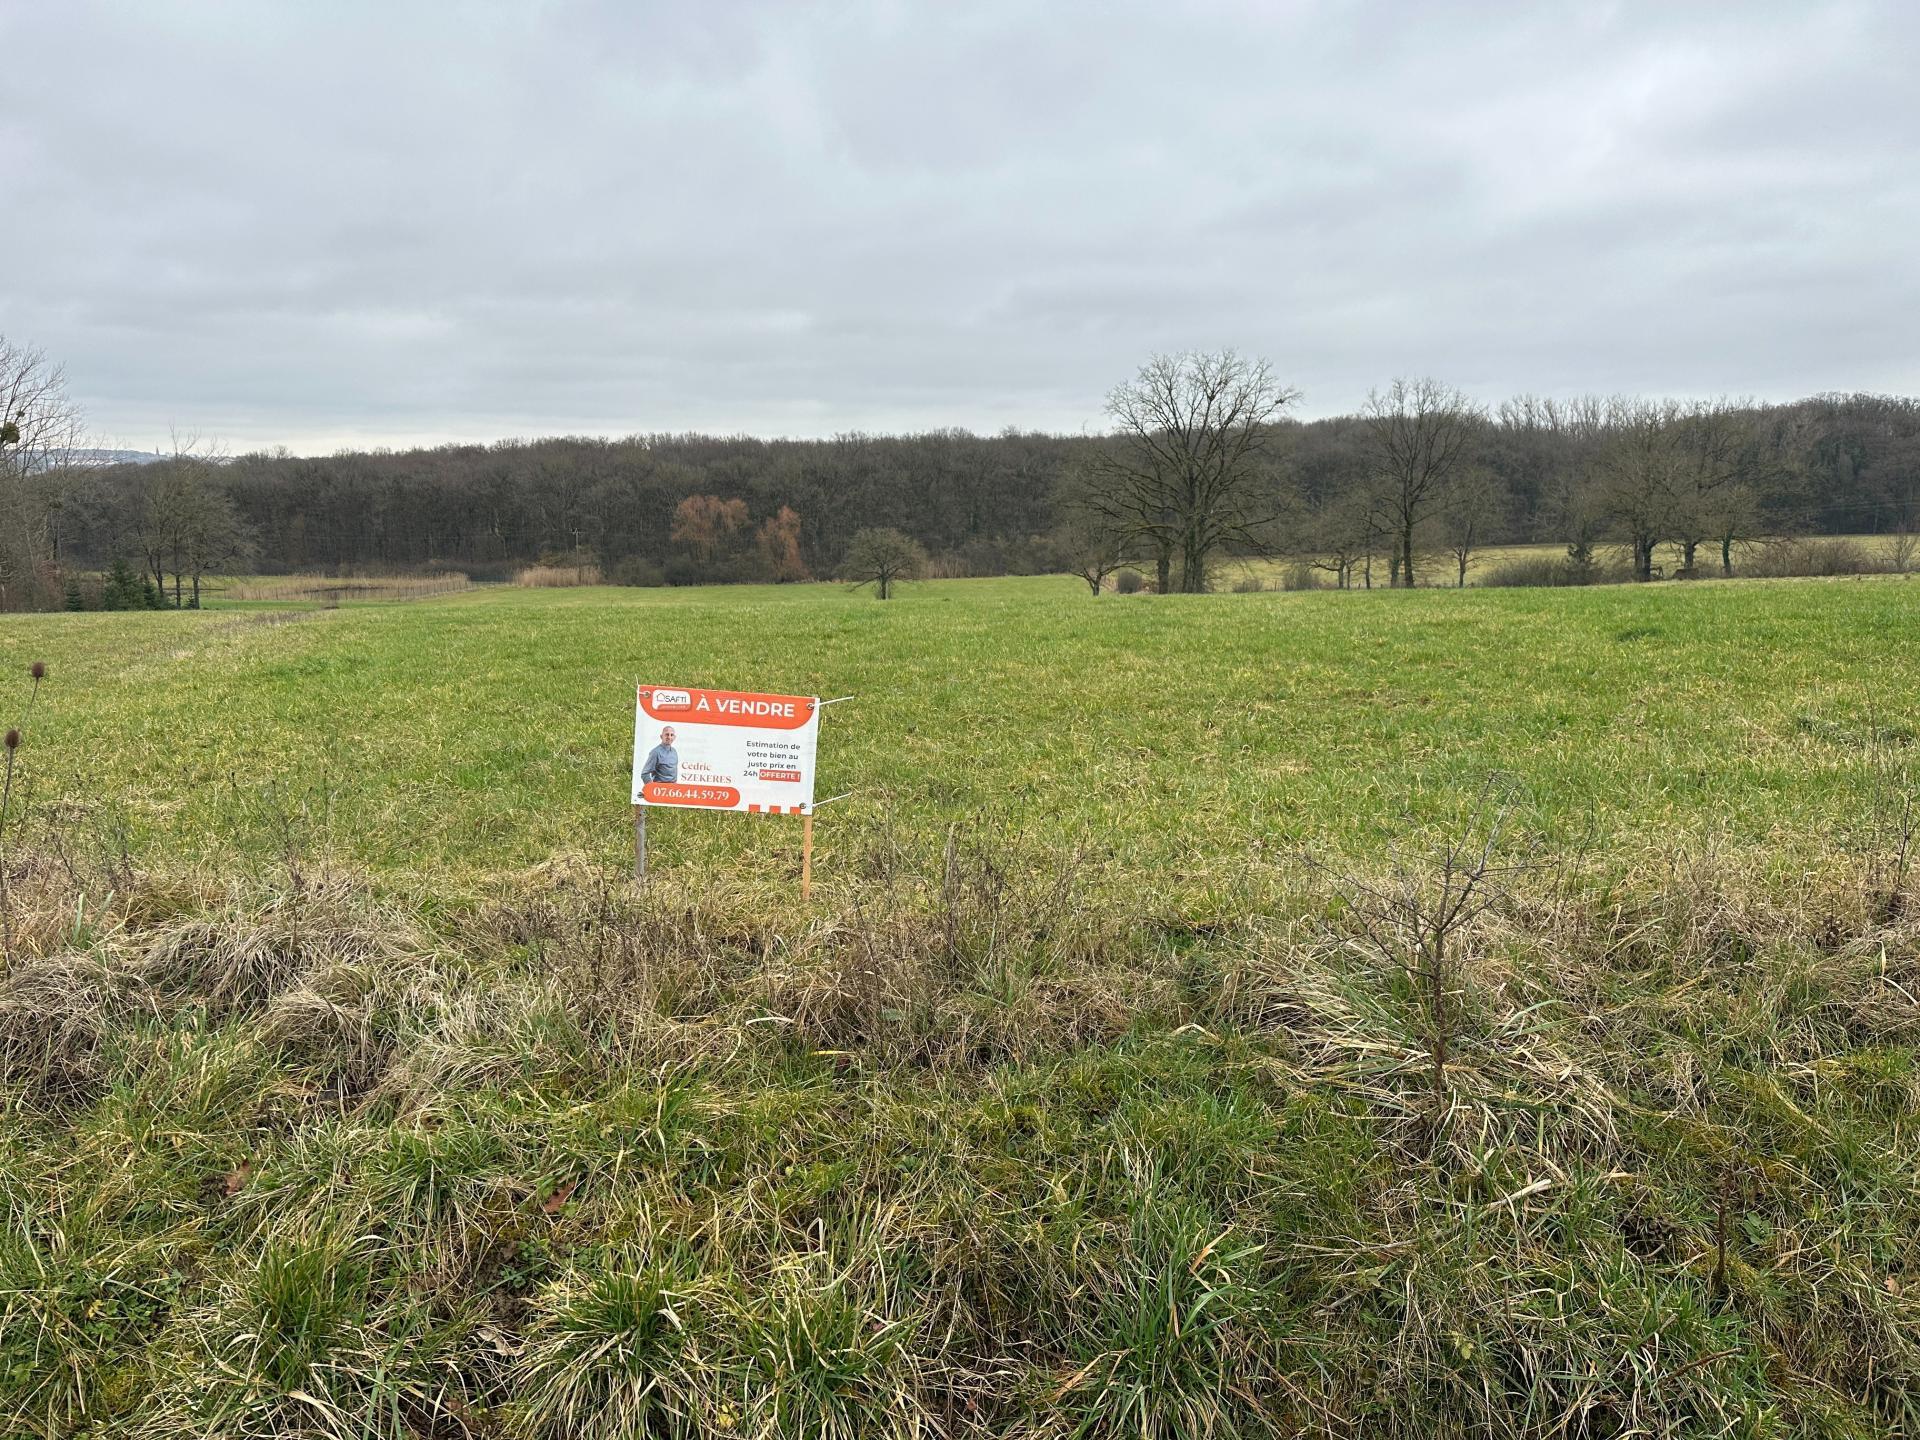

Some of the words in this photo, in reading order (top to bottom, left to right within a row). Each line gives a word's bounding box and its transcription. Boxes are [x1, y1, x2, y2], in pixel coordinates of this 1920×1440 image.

[696, 693, 711, 711] À
[716, 699, 795, 718] VENDRE
[746, 740, 788, 749] Estimation
[770, 751, 787, 759] bien
[769, 762, 785, 770] prix
[681, 773, 732, 784] SZEKERES
[653, 786, 730, 801] 07.66.44.59.79
